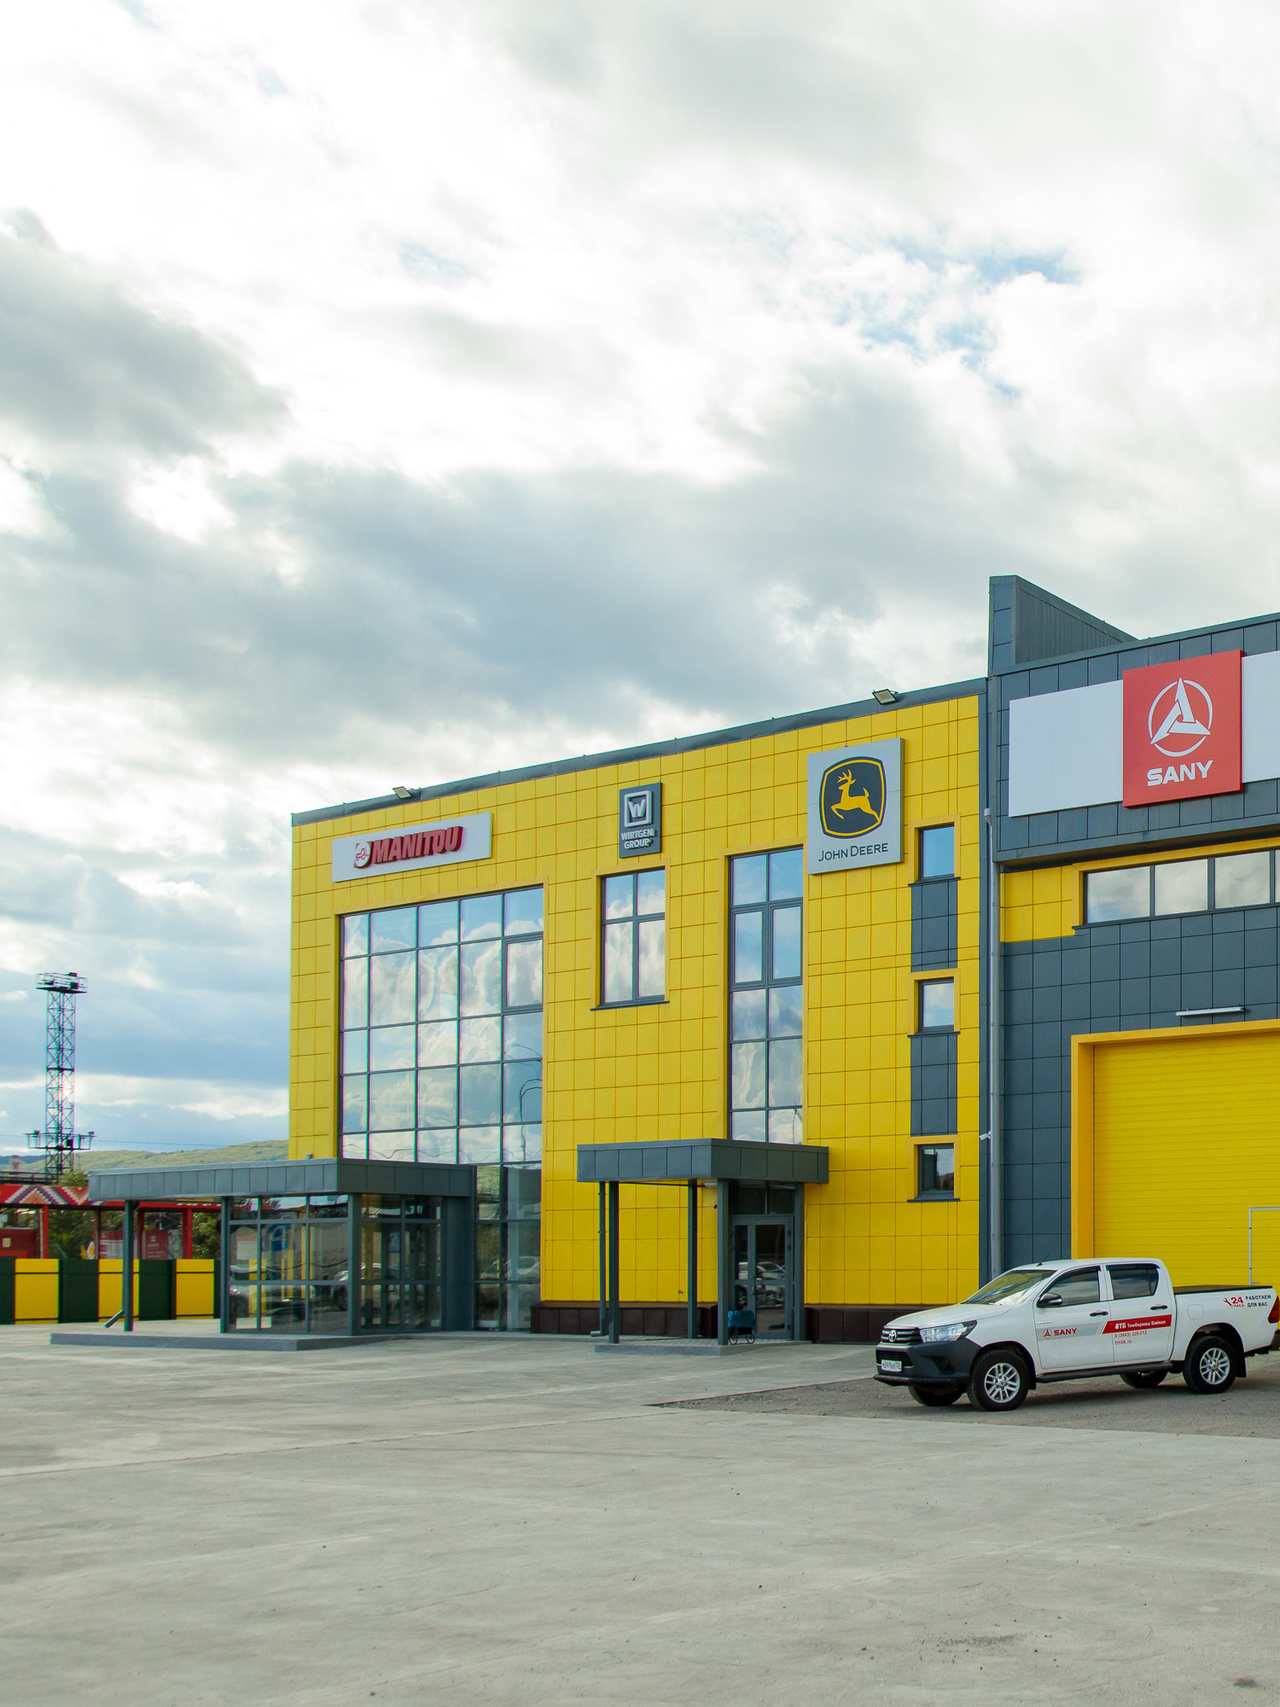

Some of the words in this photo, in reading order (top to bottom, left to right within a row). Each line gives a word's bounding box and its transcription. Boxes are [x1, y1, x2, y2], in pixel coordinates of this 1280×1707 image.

[1147, 760, 1214, 787] SANY
[621, 829, 655, 841] WIRTGEN
[371, 826, 464, 865] MANITOU
[624, 838, 652, 849] GROUP
[818, 848, 848, 862] JOHN
[850, 843, 889, 857] DEERE
[1230, 1296, 1244, 1305] 24
[1053, 1327, 1078, 1337] SANY
